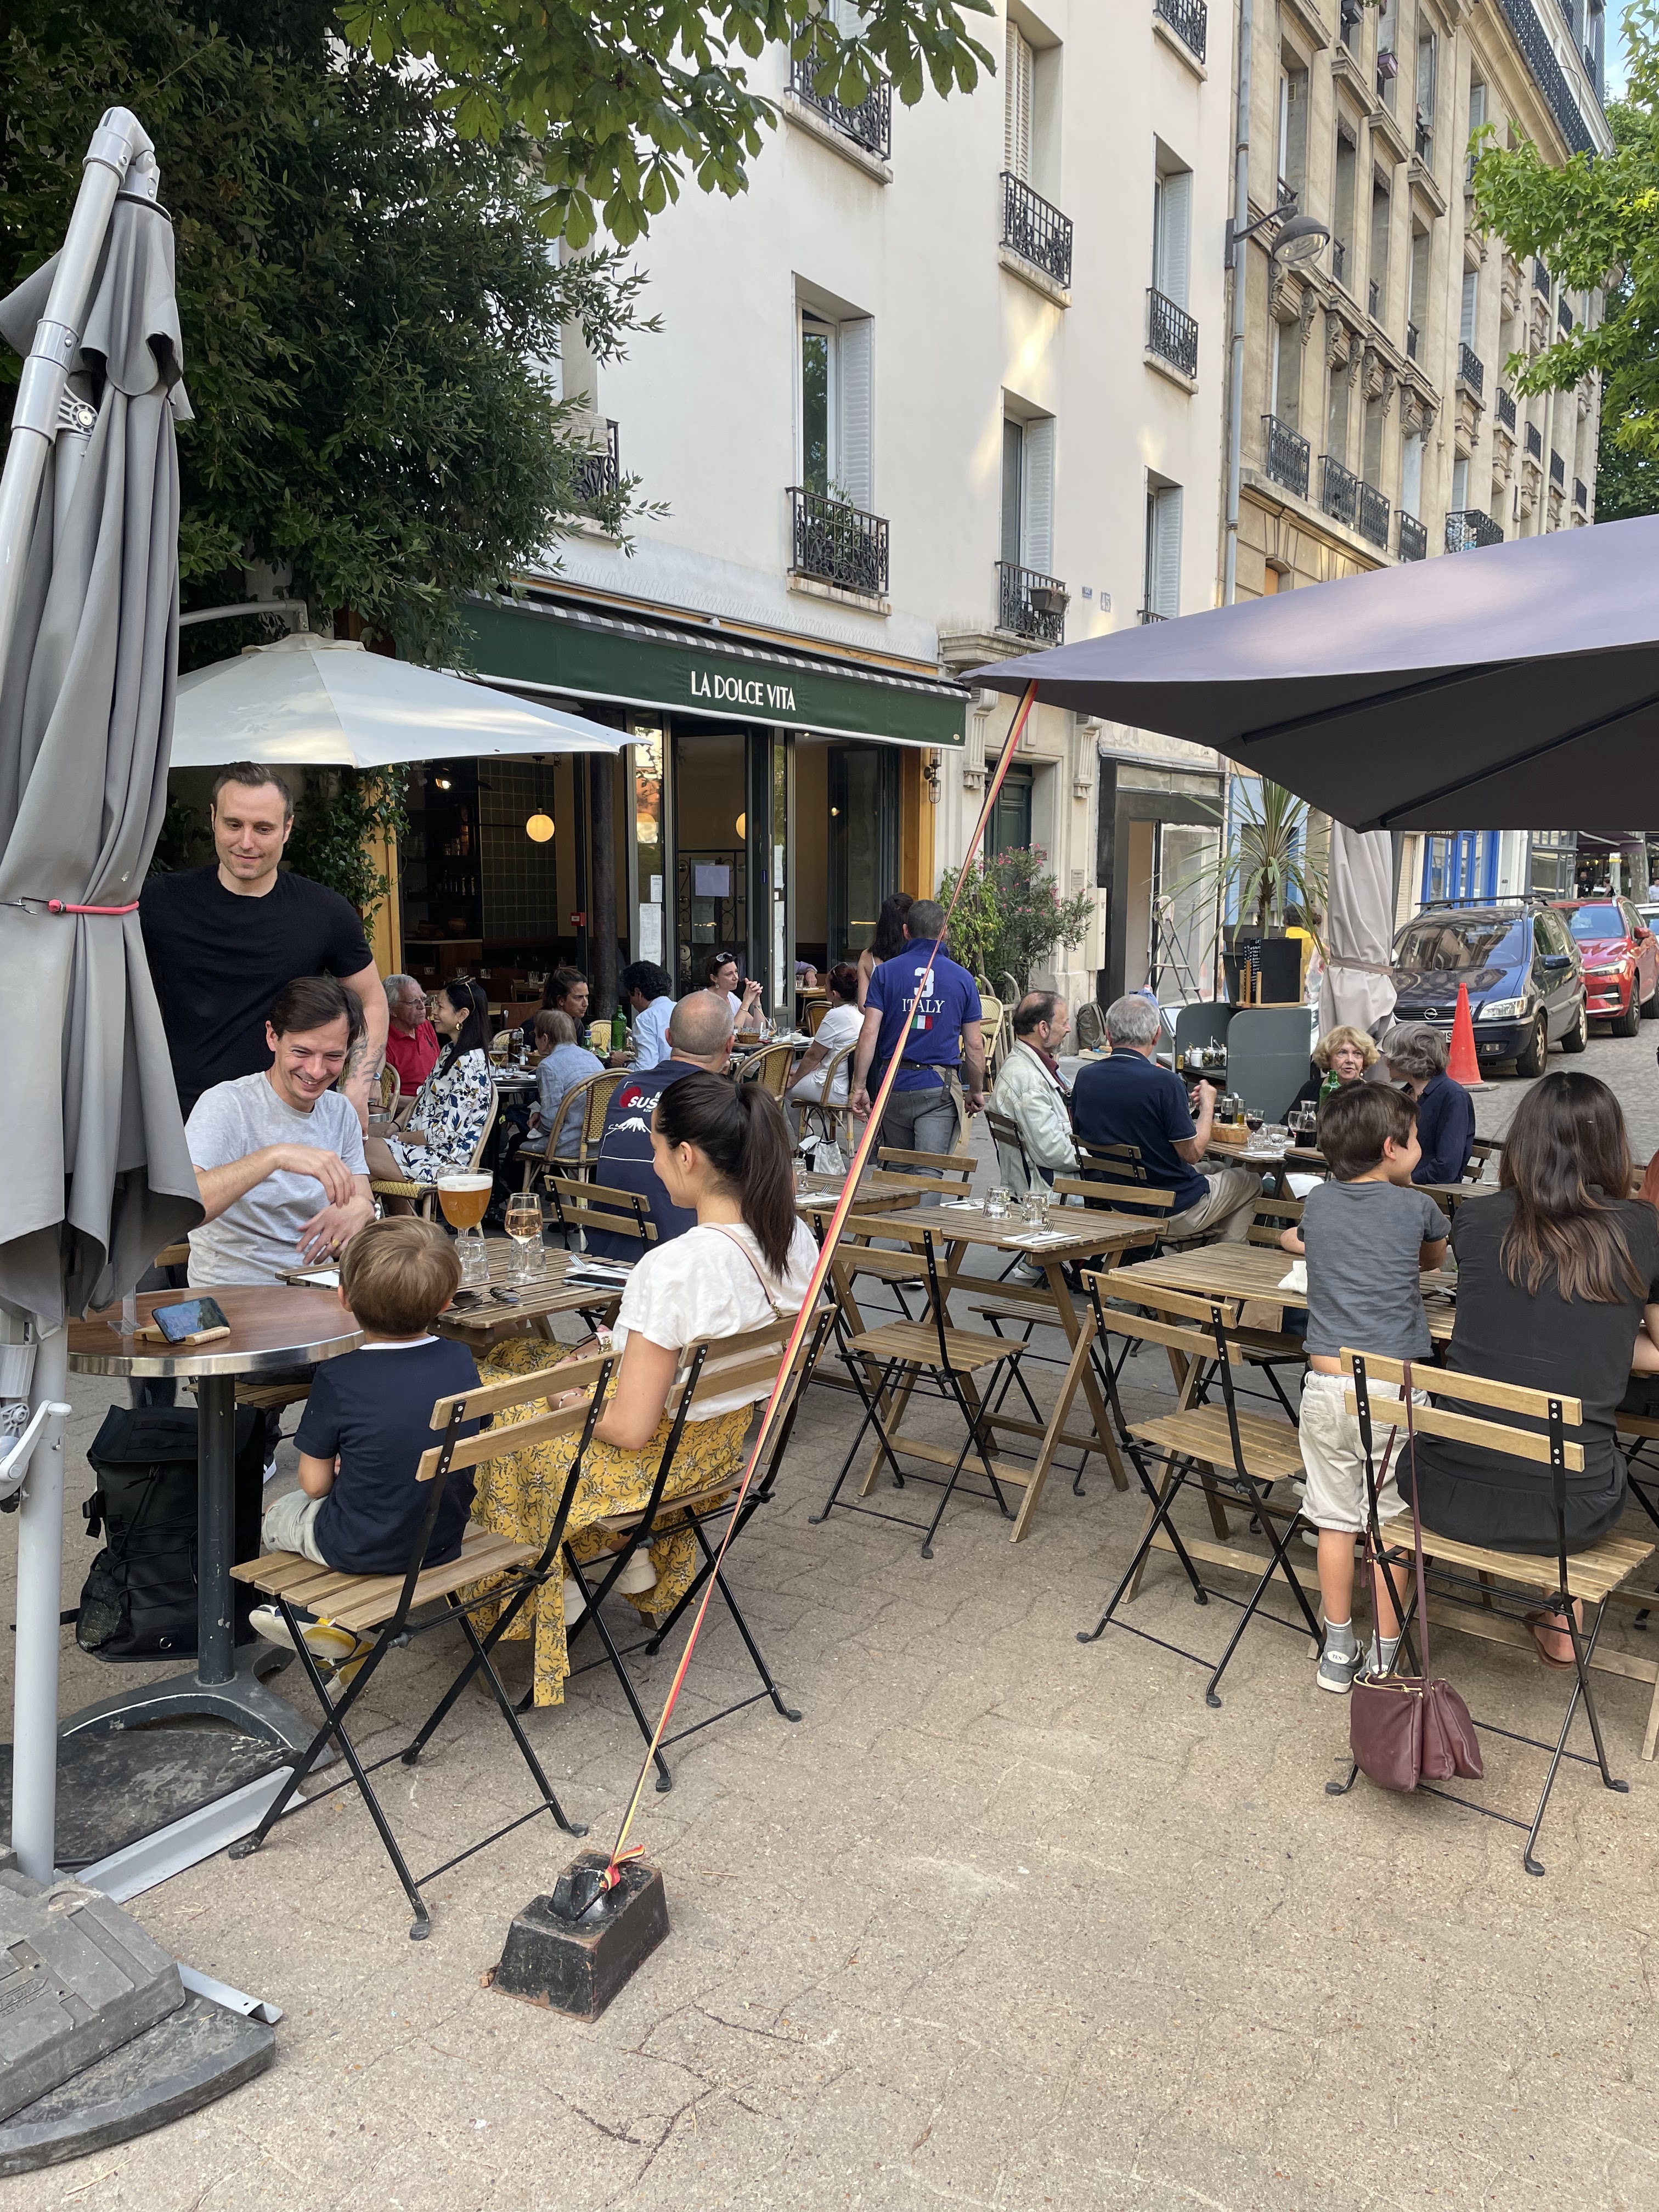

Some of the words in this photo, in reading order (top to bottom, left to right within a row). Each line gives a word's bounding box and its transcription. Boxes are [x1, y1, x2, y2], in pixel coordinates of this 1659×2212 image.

[691, 670, 712, 697] LA
[714, 674, 764, 706] DOLCE
[766, 684, 796, 711] VITA
[913, 967, 935, 997] 3
[628, 1096, 659, 1109] SUS
